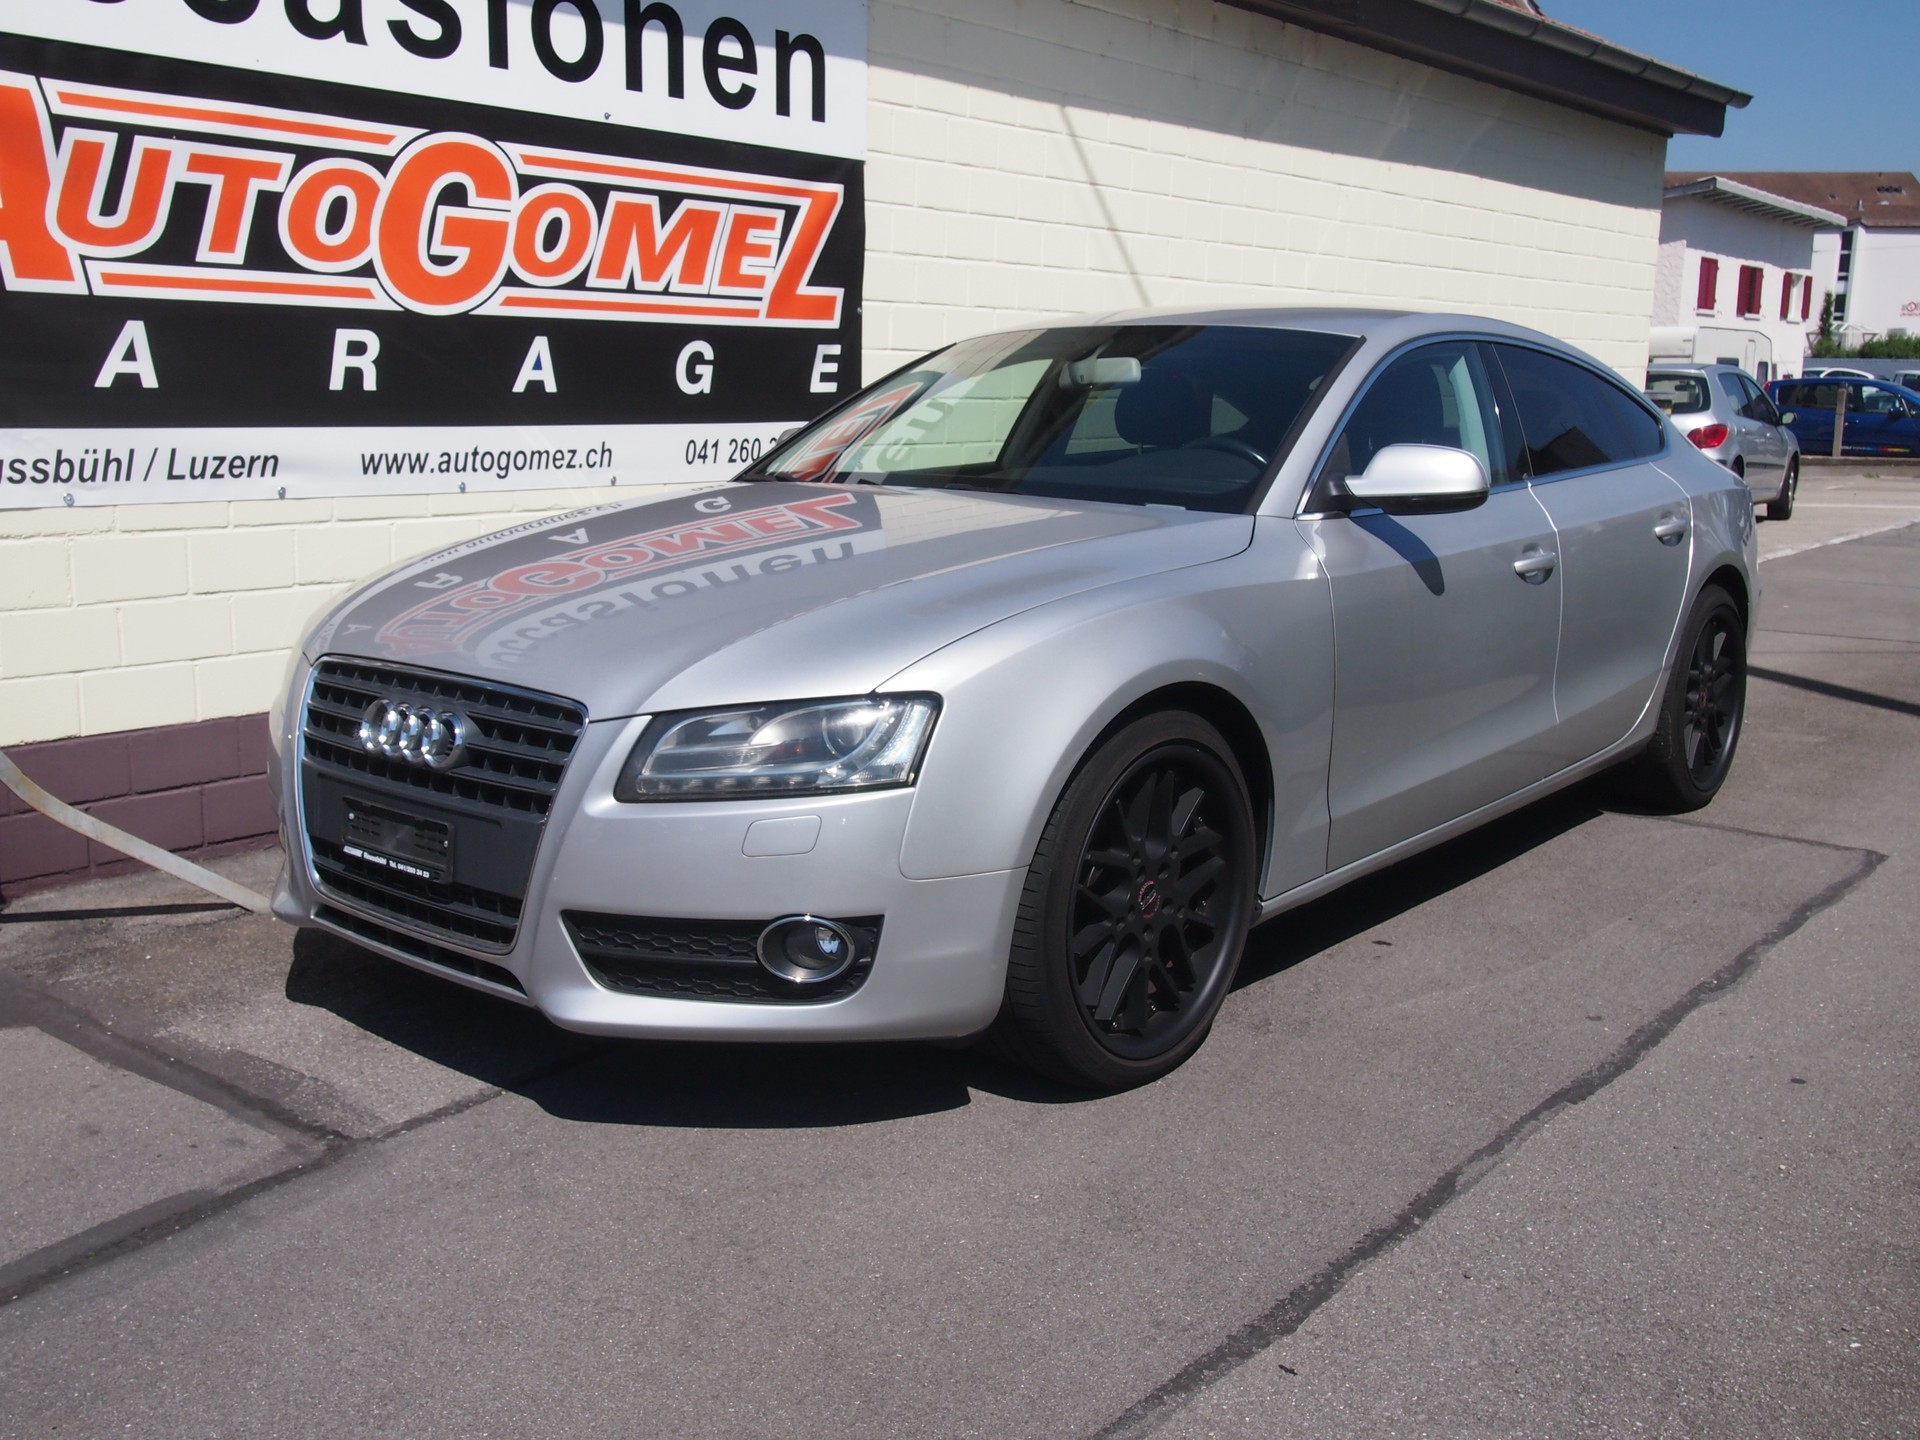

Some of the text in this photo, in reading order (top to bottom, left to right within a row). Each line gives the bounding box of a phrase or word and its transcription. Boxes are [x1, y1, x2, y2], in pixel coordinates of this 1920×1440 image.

[88, 0, 826, 123] sionen
[0, 448, 136, 485] ssbühl
[166, 448, 280, 480] Luzern
[361, 441, 613, 480] www.autogomez.ch
[685, 437, 762, 465] 041 260
